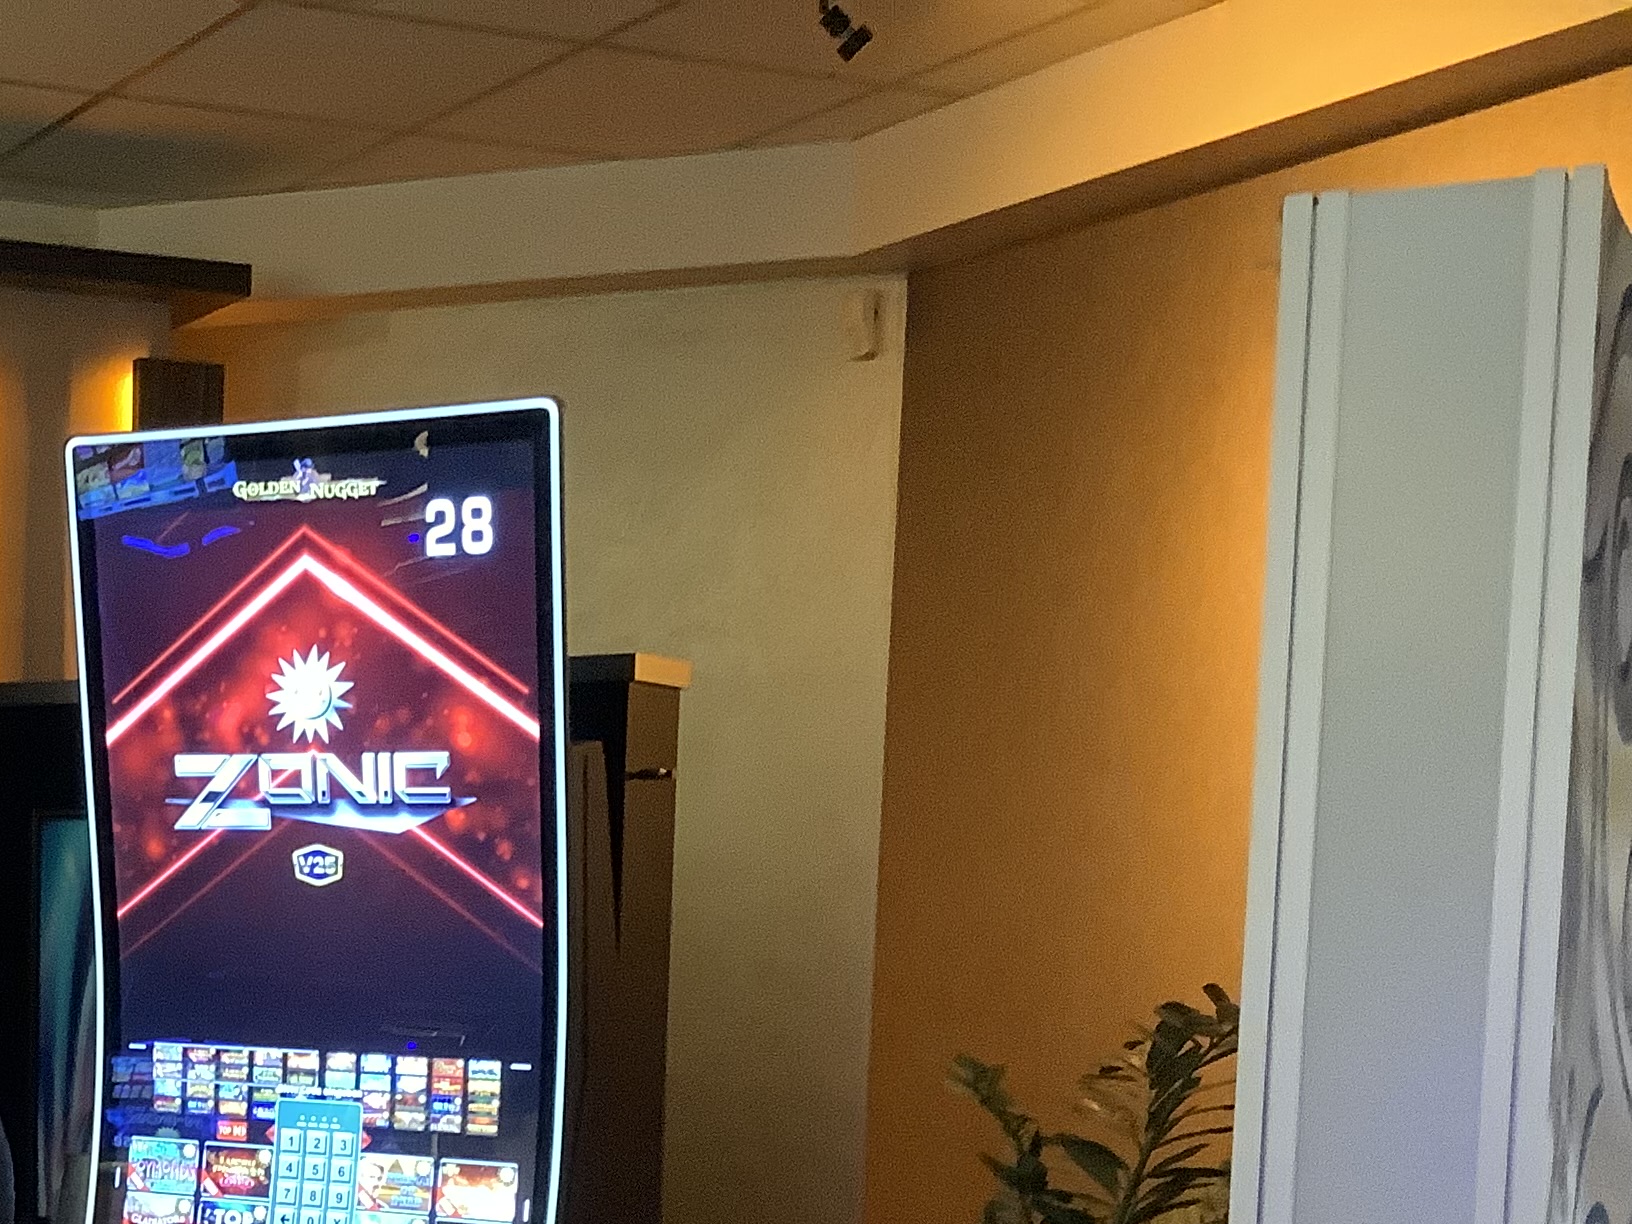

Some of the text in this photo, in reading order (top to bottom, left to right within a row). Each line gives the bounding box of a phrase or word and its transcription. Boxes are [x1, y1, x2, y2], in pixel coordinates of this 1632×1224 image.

[232, 480, 380, 500] GOLDEN NUGGET
[425, 496, 494, 557] 28
[174, 751, 452, 831] ZONIC
[298, 854, 336, 875] V25
